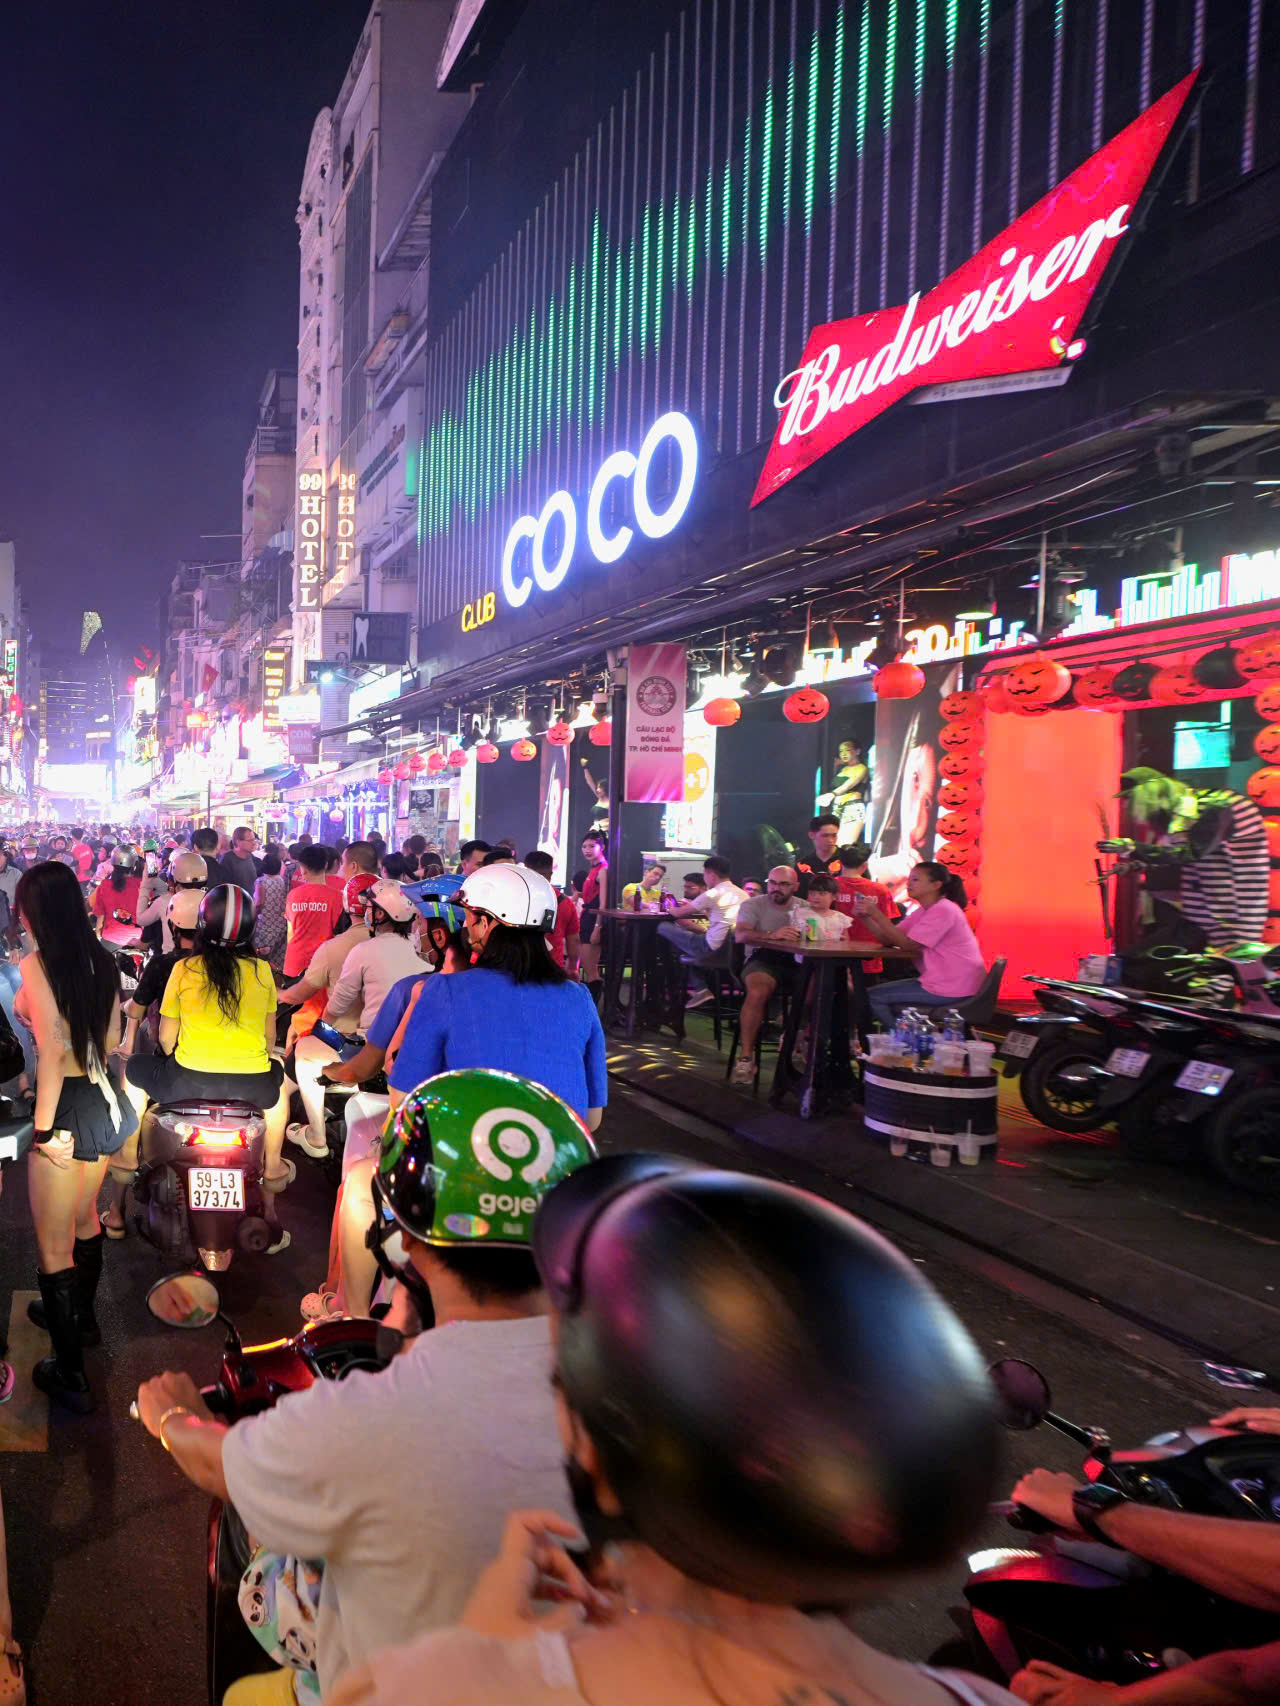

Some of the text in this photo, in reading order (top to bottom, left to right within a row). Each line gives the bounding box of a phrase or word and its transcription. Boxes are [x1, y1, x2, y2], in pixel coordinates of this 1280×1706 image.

[774, 204, 1130, 445] Budweiser
[299, 473, 322, 490] 99
[300, 496, 321, 607] HOTEL
[461, 592, 496, 632] CLUB
[197, 1172, 235, 1189] 59-L3
[193, 1190, 240, 1208] 373.74
[478, 1193, 543, 1217] goje
